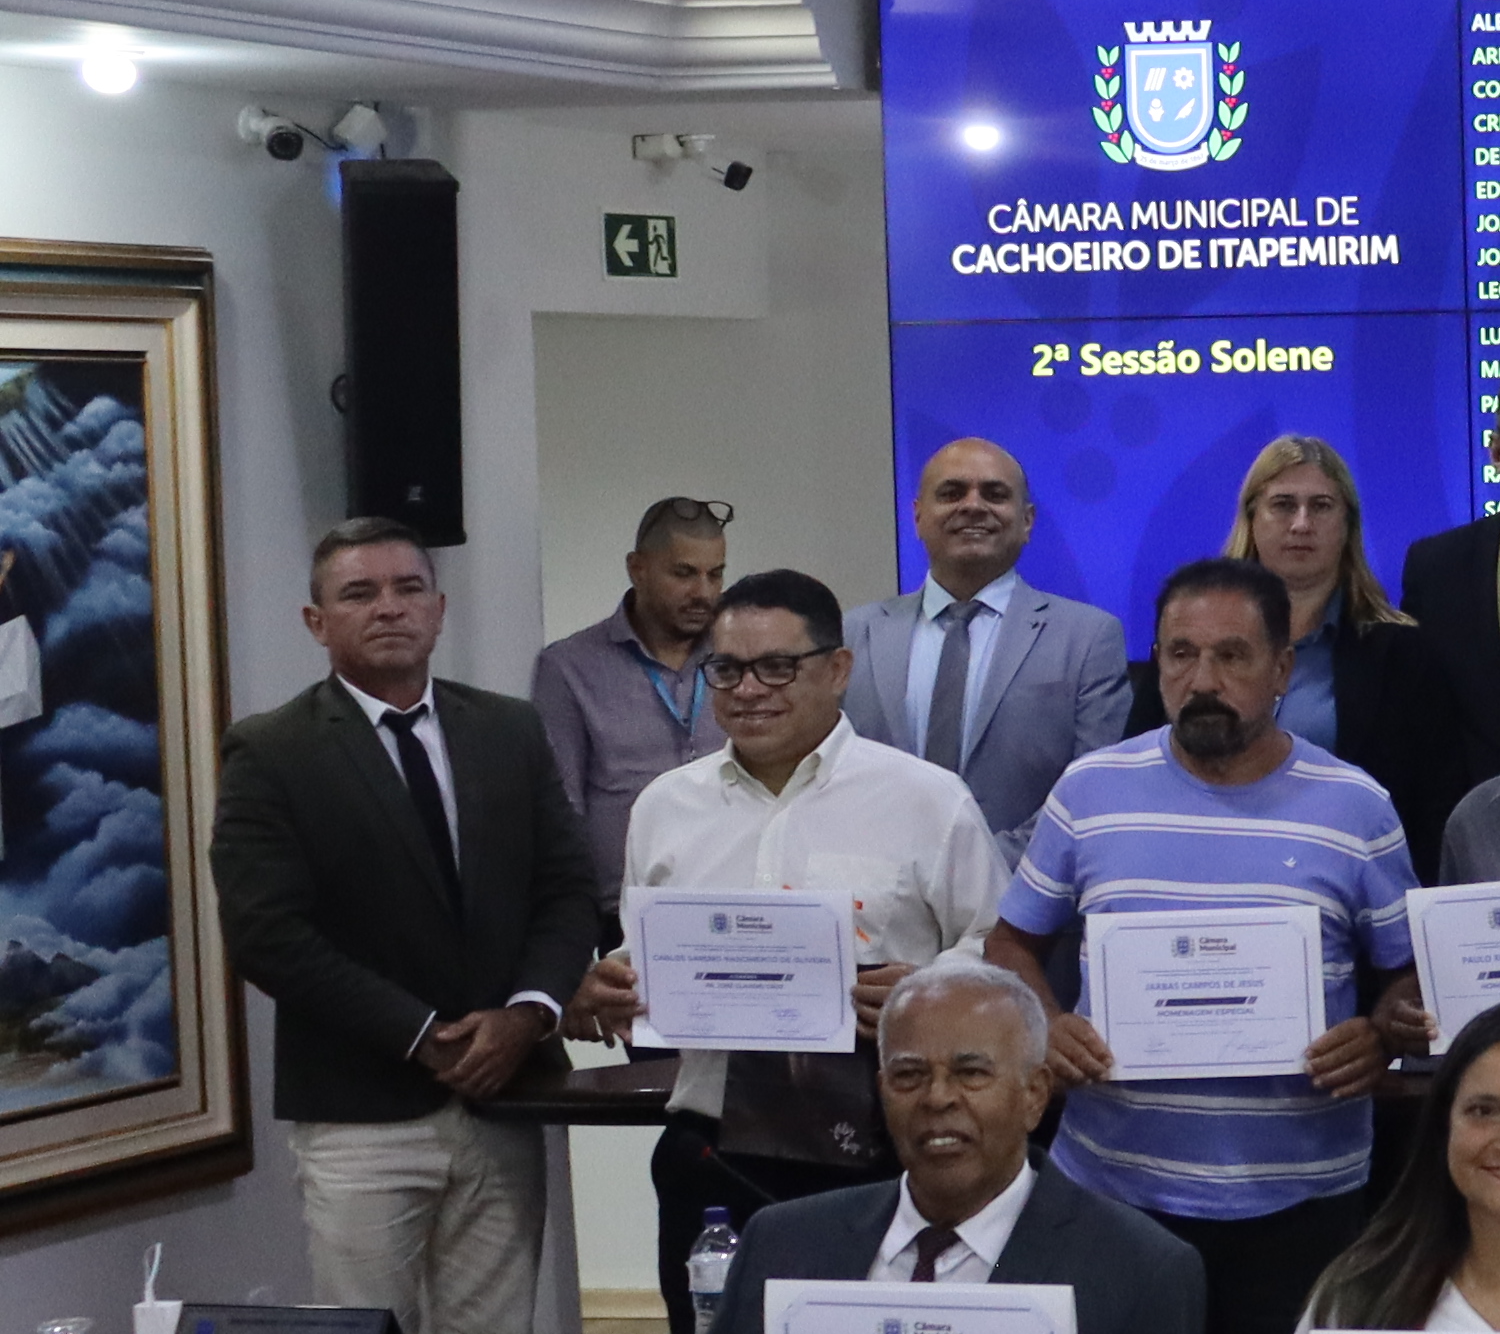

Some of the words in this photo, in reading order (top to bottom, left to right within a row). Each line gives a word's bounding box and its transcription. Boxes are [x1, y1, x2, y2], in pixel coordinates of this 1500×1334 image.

[989, 199, 1123, 233] CÂMARA
[1132, 198, 1307, 229] MUNICIPAL
[1317, 196, 1359, 225] DE
[952, 240, 1150, 274] CACHOEIRO
[1159, 240, 1202, 269] DE
[1210, 235, 1398, 268] ITAPEMIRIM
[1033, 344, 1069, 376] 2ª
[1081, 341, 1200, 375] Sessão
[1211, 339, 1333, 373] Solene
[914, 1321, 952, 1332] Câmara
